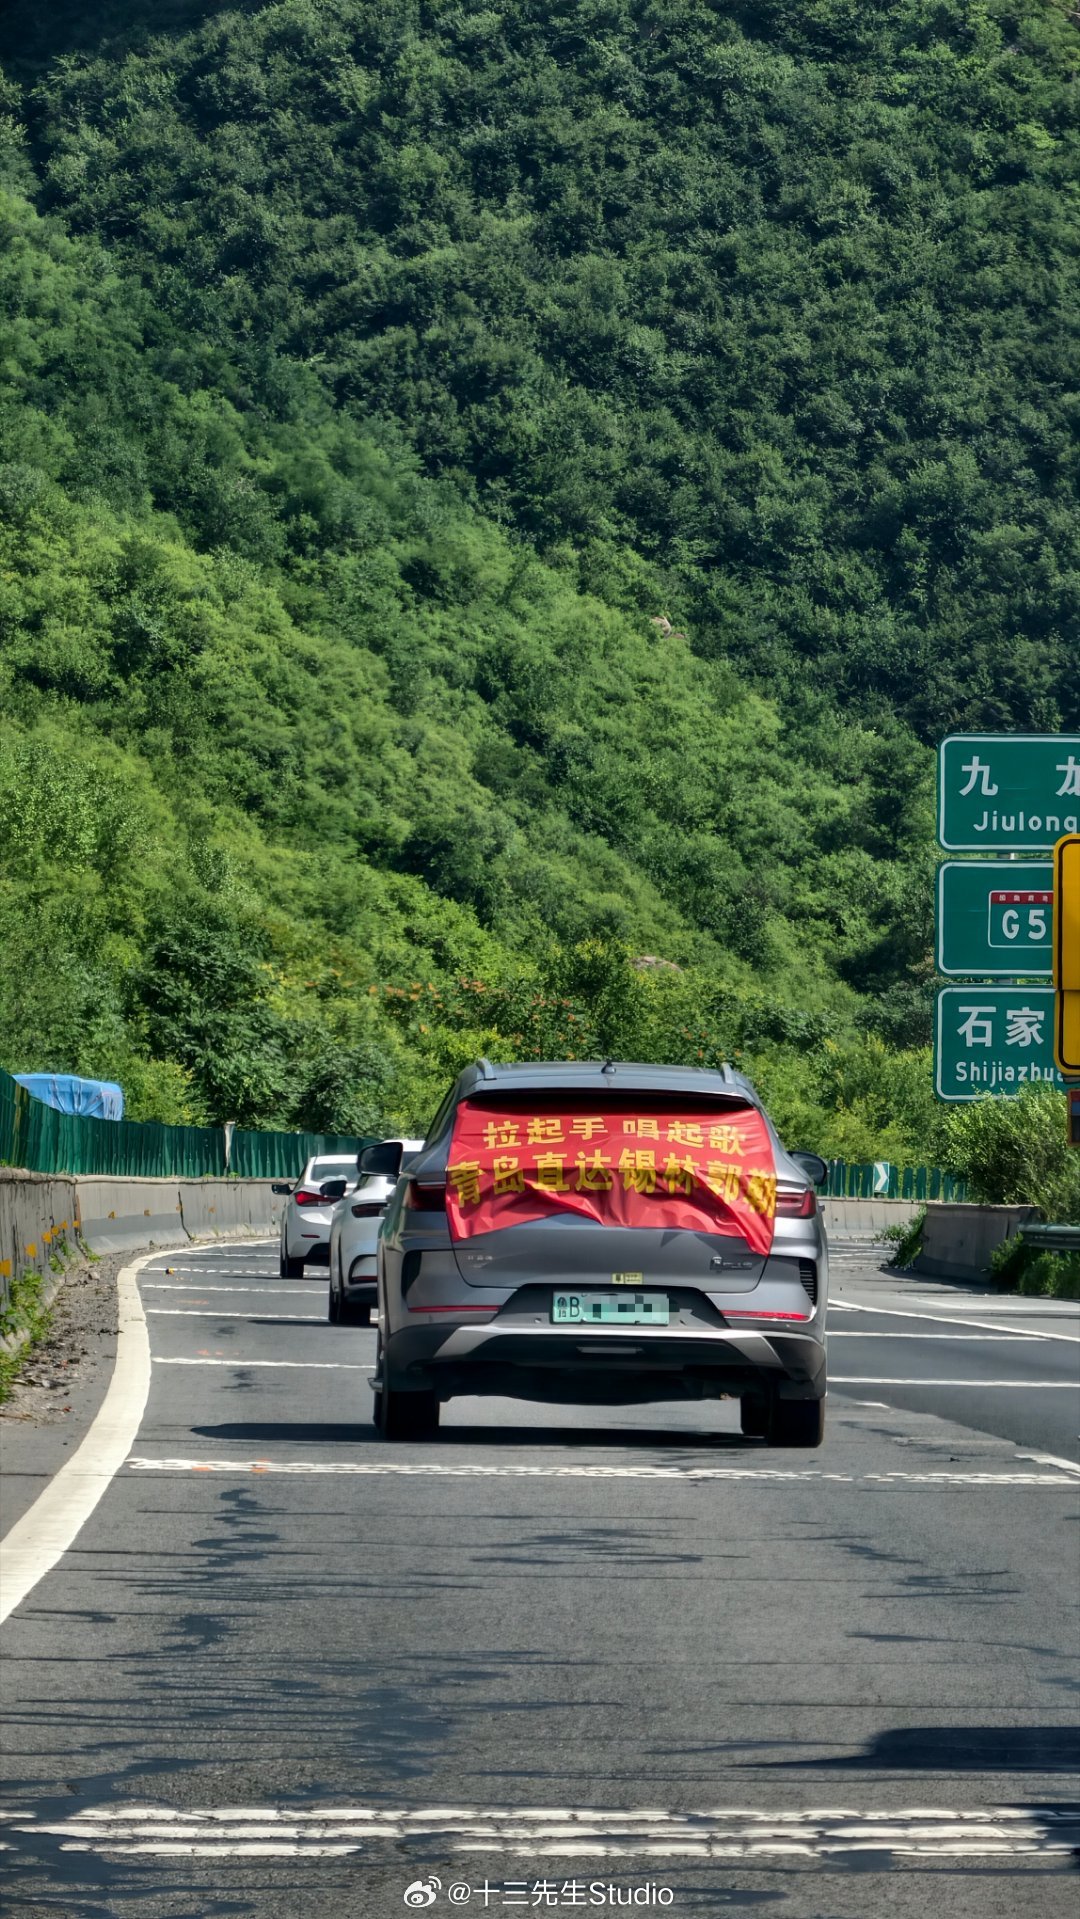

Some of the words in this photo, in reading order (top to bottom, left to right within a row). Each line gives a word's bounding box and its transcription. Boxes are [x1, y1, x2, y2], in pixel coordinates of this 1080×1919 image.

[973, 810, 1077, 834] Jiulong
[1001, 909, 1047, 940] G5
[956, 1005, 1046, 1048] 石家
[482, 1116, 609, 1150] 拉起手
[622, 1117, 747, 1157] 唱起歌
